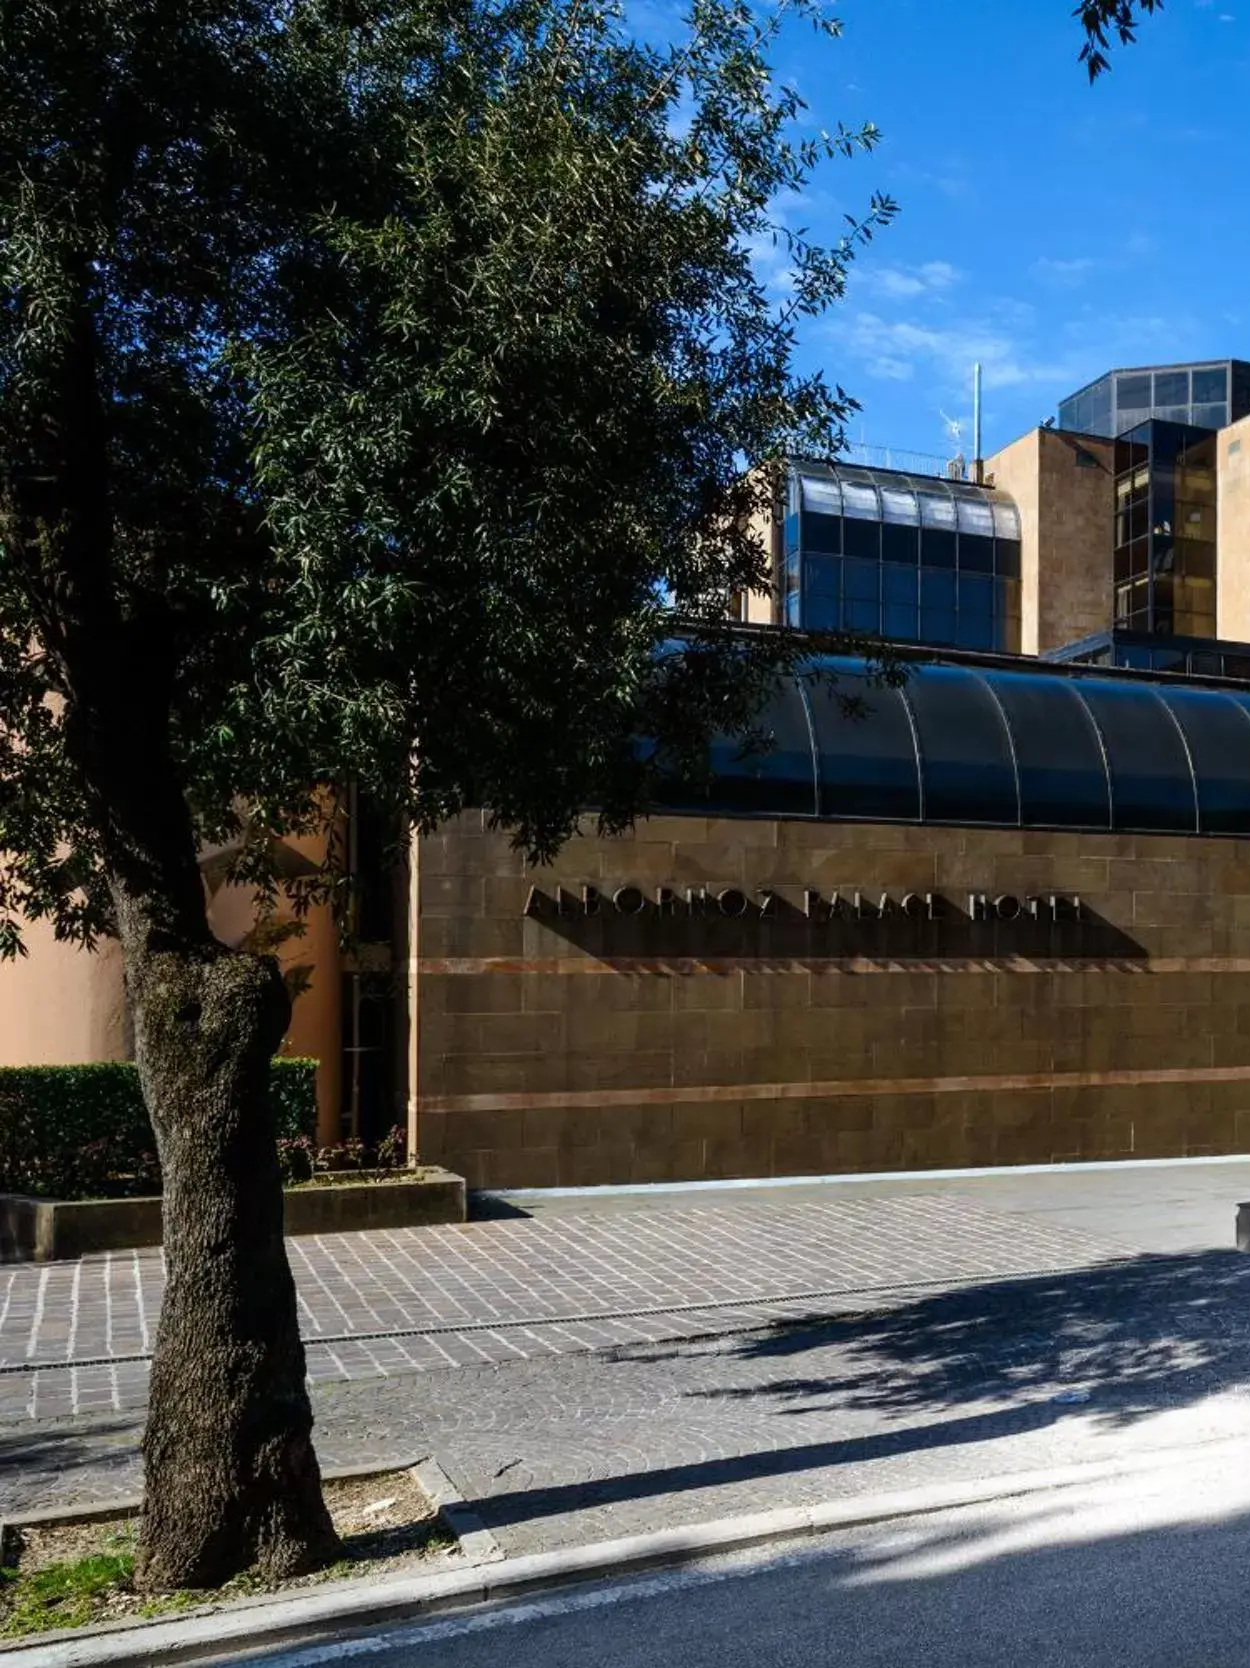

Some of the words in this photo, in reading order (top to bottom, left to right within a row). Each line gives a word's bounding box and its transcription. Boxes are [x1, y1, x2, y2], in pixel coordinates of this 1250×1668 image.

[522, 884, 776, 917] ALBORNOZ
[803, 889, 943, 919] PALACE
[968, 893, 1087, 921] HOTEL
